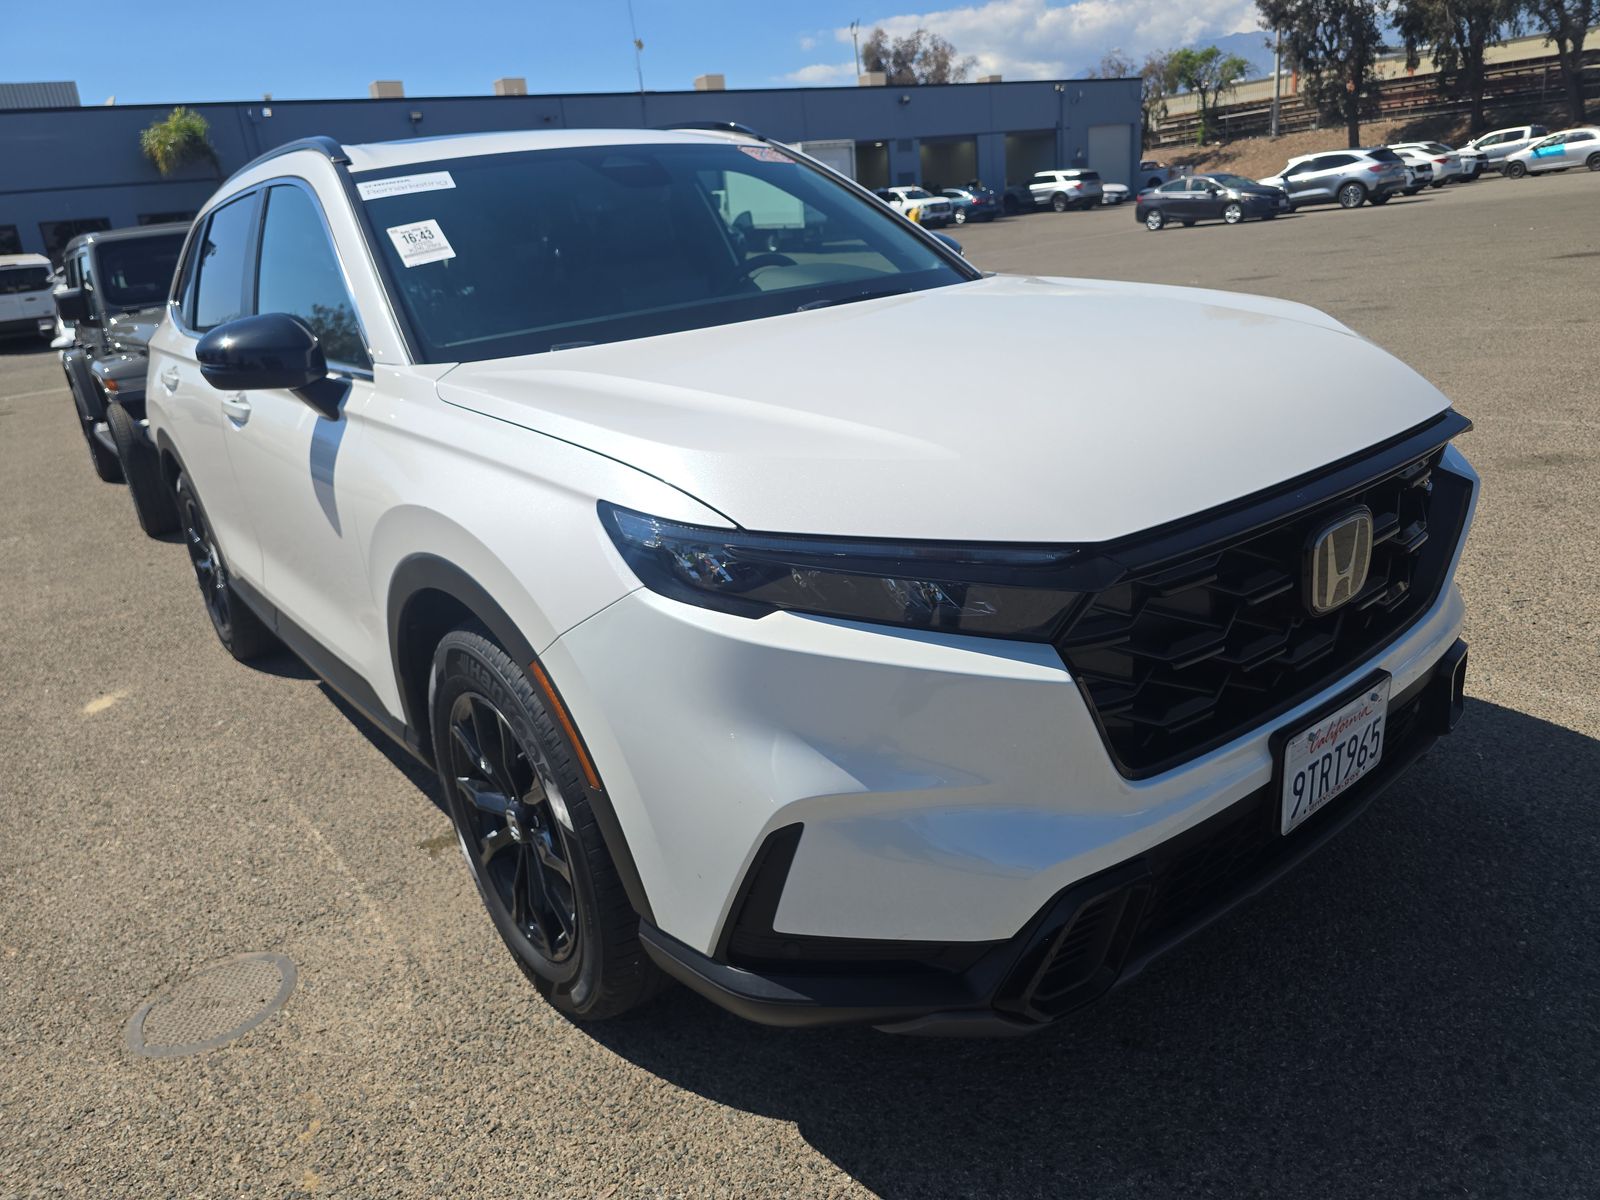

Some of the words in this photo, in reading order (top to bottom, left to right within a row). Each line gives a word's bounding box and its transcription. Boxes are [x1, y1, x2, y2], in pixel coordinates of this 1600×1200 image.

[401, 229, 434, 244] 16:43
[1309, 704, 1373, 754] California
[1291, 716, 1382, 820] 9TRT965
